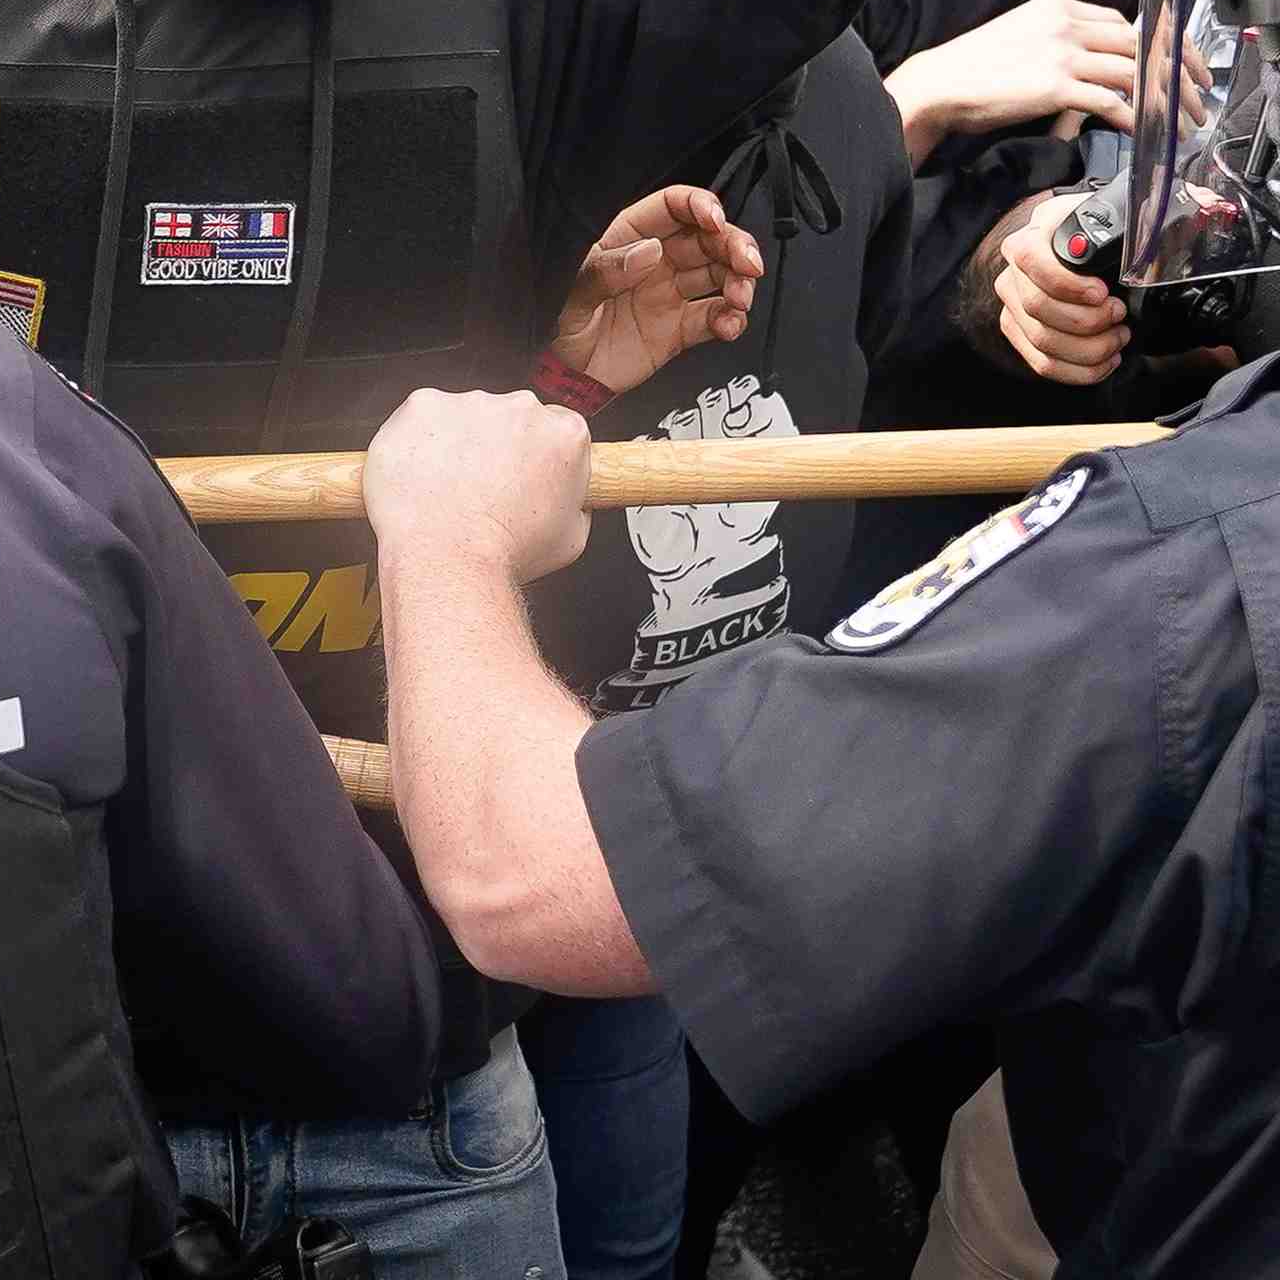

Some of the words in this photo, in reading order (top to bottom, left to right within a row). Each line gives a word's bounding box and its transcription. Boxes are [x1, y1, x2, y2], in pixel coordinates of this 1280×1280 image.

[148, 260, 197, 279] GOOD
[242, 260, 287, 279] ONLY
[653, 606, 764, 665] BLACK
